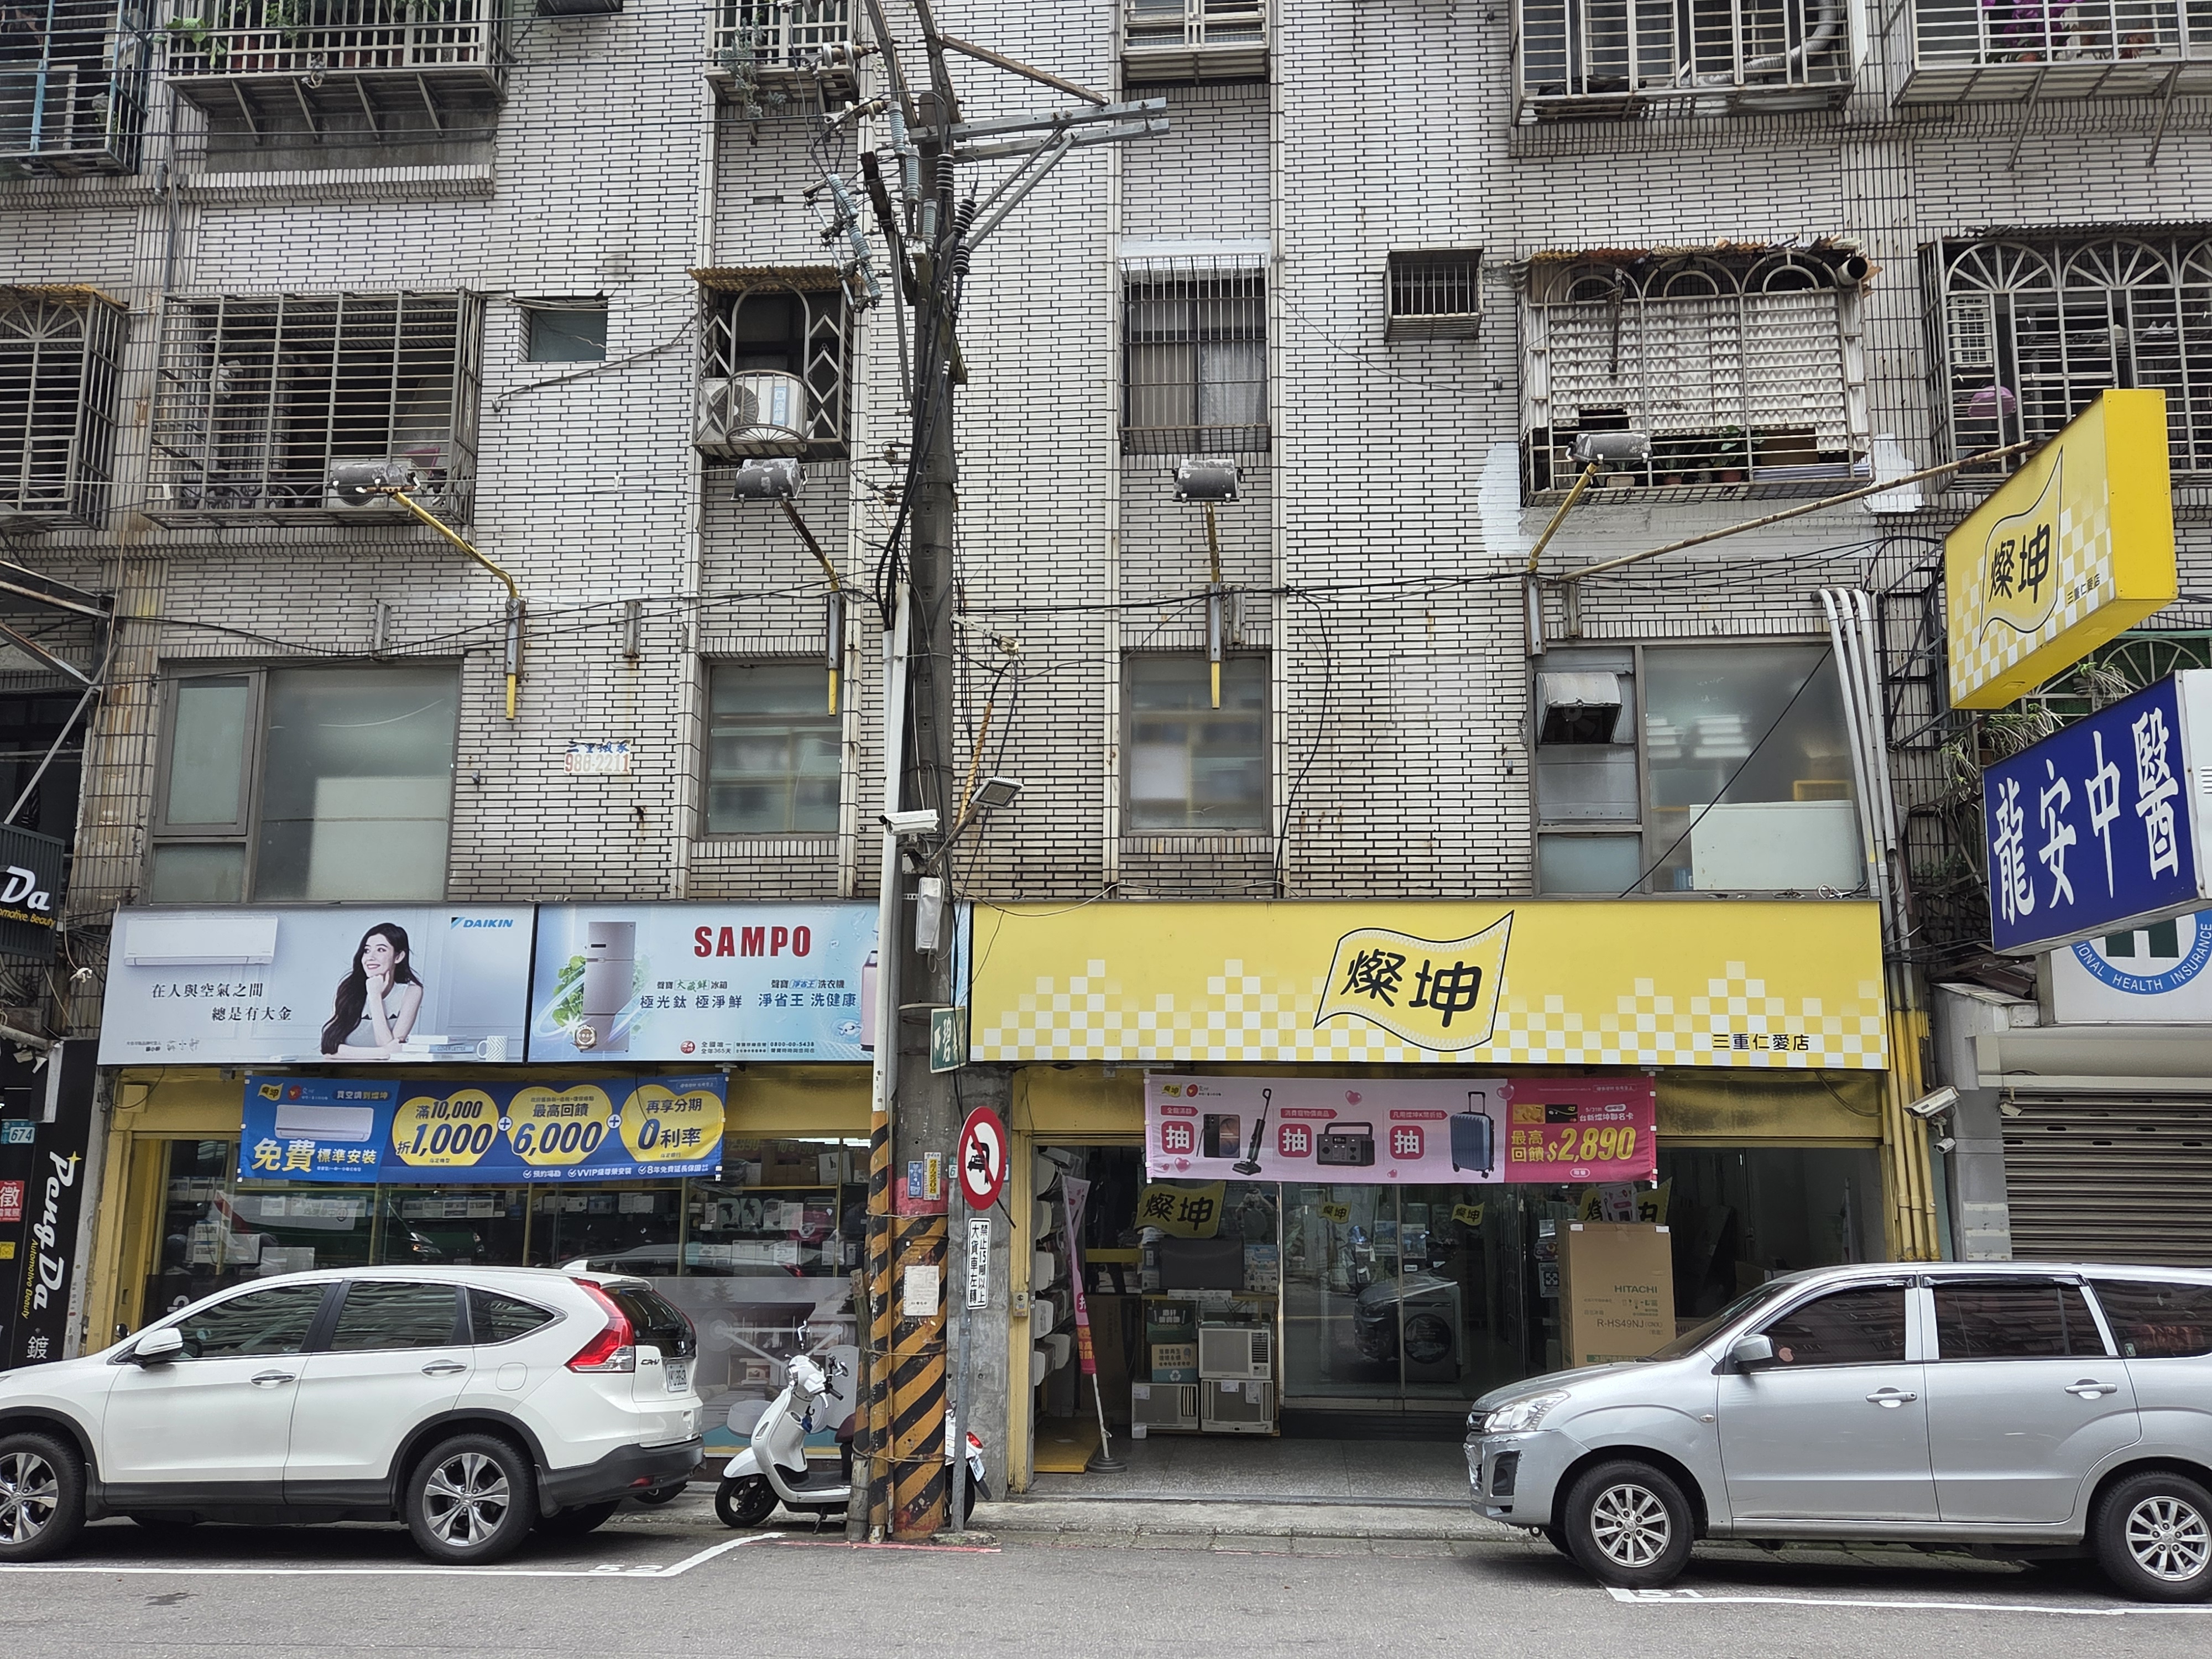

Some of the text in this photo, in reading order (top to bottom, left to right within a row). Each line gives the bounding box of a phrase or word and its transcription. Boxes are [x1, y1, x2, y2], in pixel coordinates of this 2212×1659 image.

[1989, 523, 2050, 604] 燦坤
[1994, 707, 2179, 926] 龍安中醫
[0, 865, 51, 911] Da
[463, 918, 513, 928] DAIKIN
[694, 926, 811, 957] SAMPO
[2075, 923, 2212, 992] IONAL HEALTH INSURANCE
[150, 983, 263, 999] 在人與空氣之間
[1340, 948, 1482, 1027] 燦坤
[759, 993, 857, 1007] 淨省王 洗健康
[211, 1006, 292, 1022] 總是有大金
[1712, 1034, 1810, 1052] 三重仁愛店
[533, 1103, 589, 1118] 最高回饋
[645, 1098, 702, 1114] 再享分期
[11, 1129, 34, 1142] 674
[513, 1121, 602, 1157] 6,000
[1166, 1125, 1190, 1149] 抽
[1282, 1128, 1307, 1152] 抽
[1394, 1130, 1420, 1154] 抽
[1511, 1130, 1543, 1145] 最高
[1546, 1127, 1636, 1162] $2,890
[251, 1138, 316, 1173] 免費
[317, 1148, 377, 1164] 標準安裝
[1511, 1146, 1545, 1162] 回饋
[1143, 1193, 1214, 1231] 燦坤
[969, 1224, 979, 1304] 大貨車左轉
[1614, 1285, 1658, 1293] HITACHI
[27, 1335, 49, 1359] 鍍
[588, 1564, 663, 1573] 52
